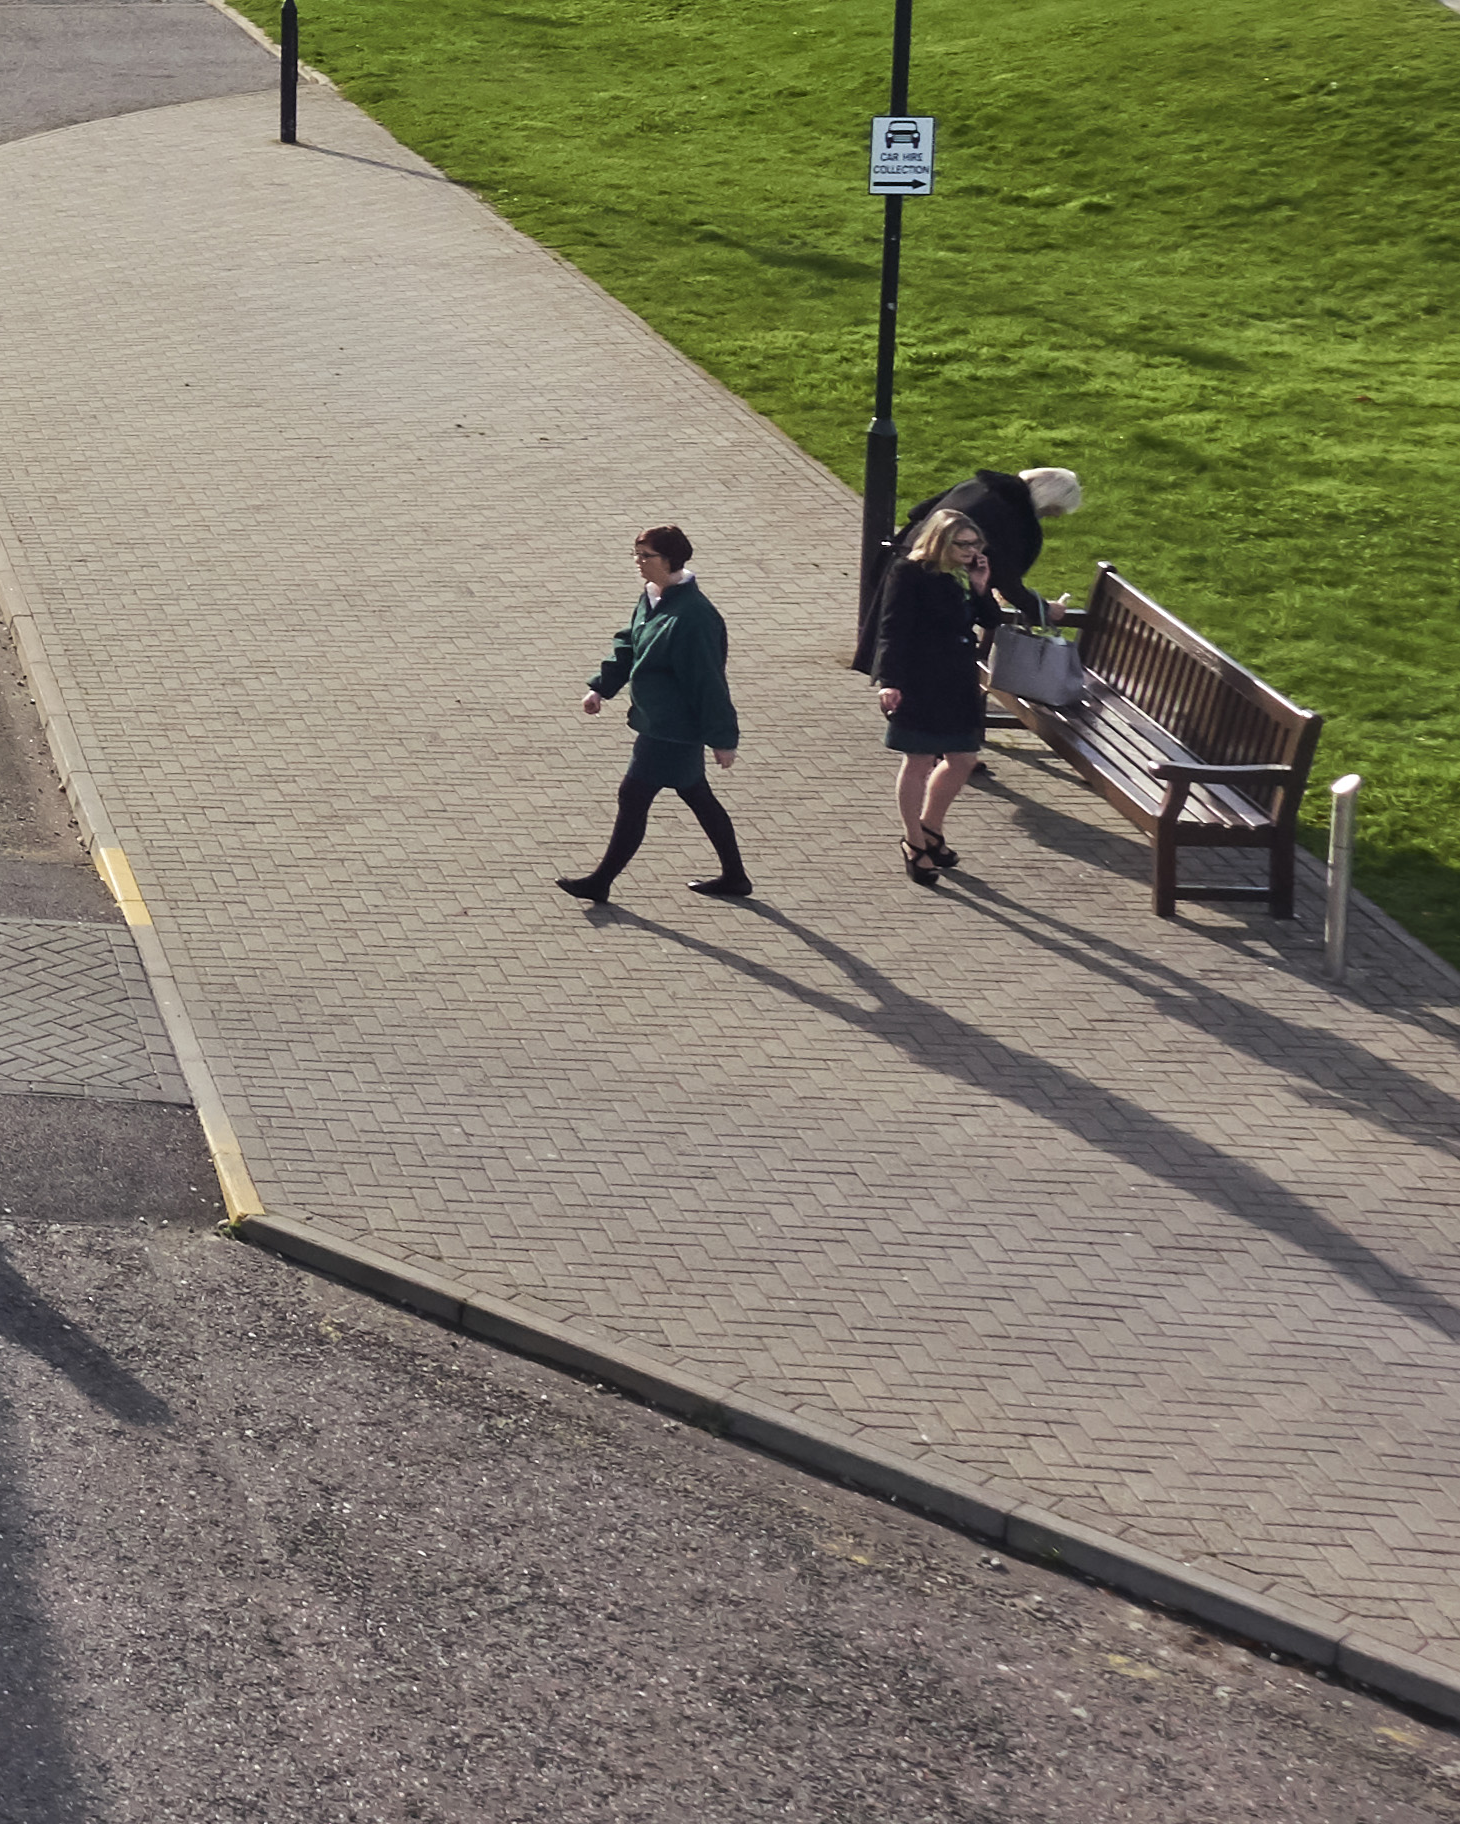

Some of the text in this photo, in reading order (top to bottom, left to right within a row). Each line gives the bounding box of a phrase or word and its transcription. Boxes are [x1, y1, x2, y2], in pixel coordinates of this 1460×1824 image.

[880, 152, 923, 162] CAR HIRE
[873, 164, 930, 175] COLLECTION
